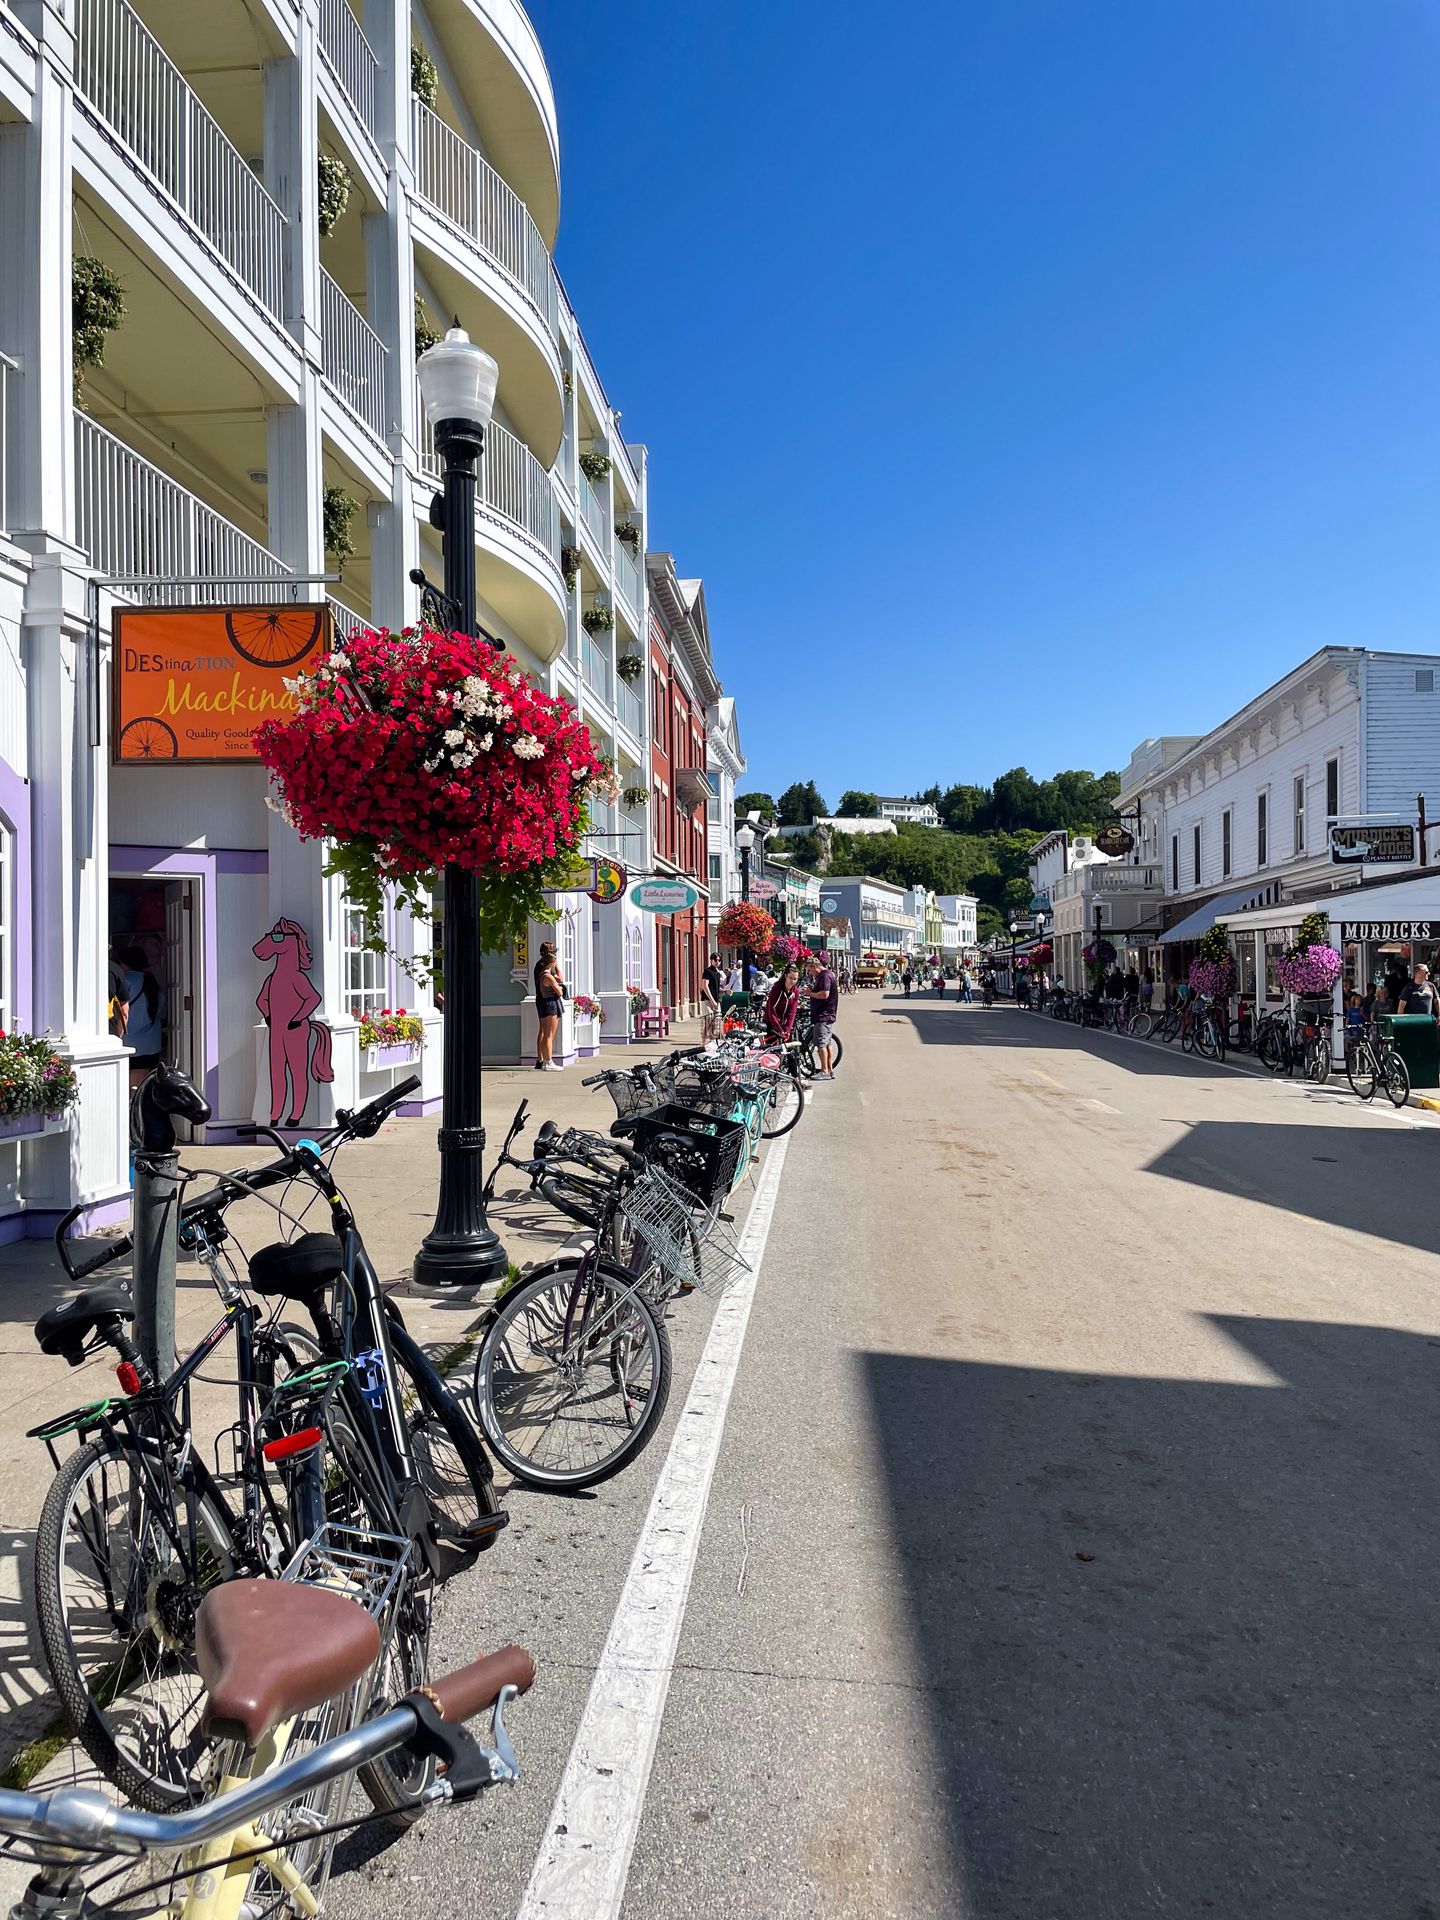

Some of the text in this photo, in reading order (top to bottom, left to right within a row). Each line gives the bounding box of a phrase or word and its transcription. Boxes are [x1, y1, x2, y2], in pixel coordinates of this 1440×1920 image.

[125, 649, 235, 672] DEStinaTION
[153, 671, 301, 717] Mackina
[185, 728, 253, 741] Quality Goods
[224, 740, 250, 750] Since
[1334, 827, 1412, 848] MURDICK'S
[1370, 841, 1412, 856] FUDGE
[1344, 922, 1431, 939] MURDICKS
